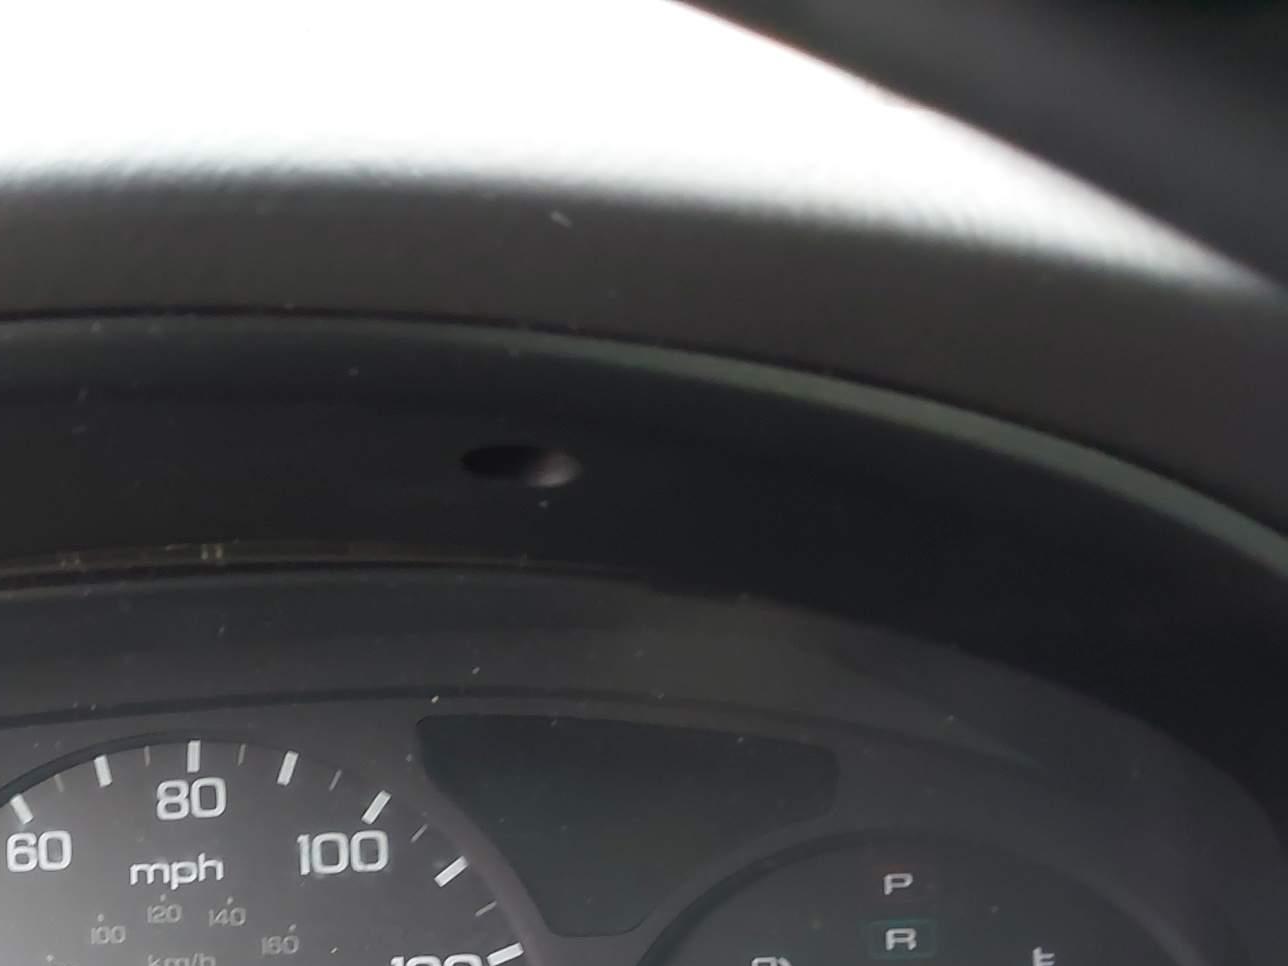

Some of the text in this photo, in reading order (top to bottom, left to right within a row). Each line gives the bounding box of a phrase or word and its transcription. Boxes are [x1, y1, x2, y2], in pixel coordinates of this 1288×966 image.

[156, 777, 227, 820] 80
[6, 830, 72, 872] 60
[297, 829, 389, 876] 100
[130, 852, 224, 890] mph
[883, 873, 913, 895] P
[147, 904, 183, 923] 120
[208, 907, 246, 927] 140
[89, 926, 126, 945] 100
[262, 935, 299, 955] 160
[885, 928, 916, 951] R
